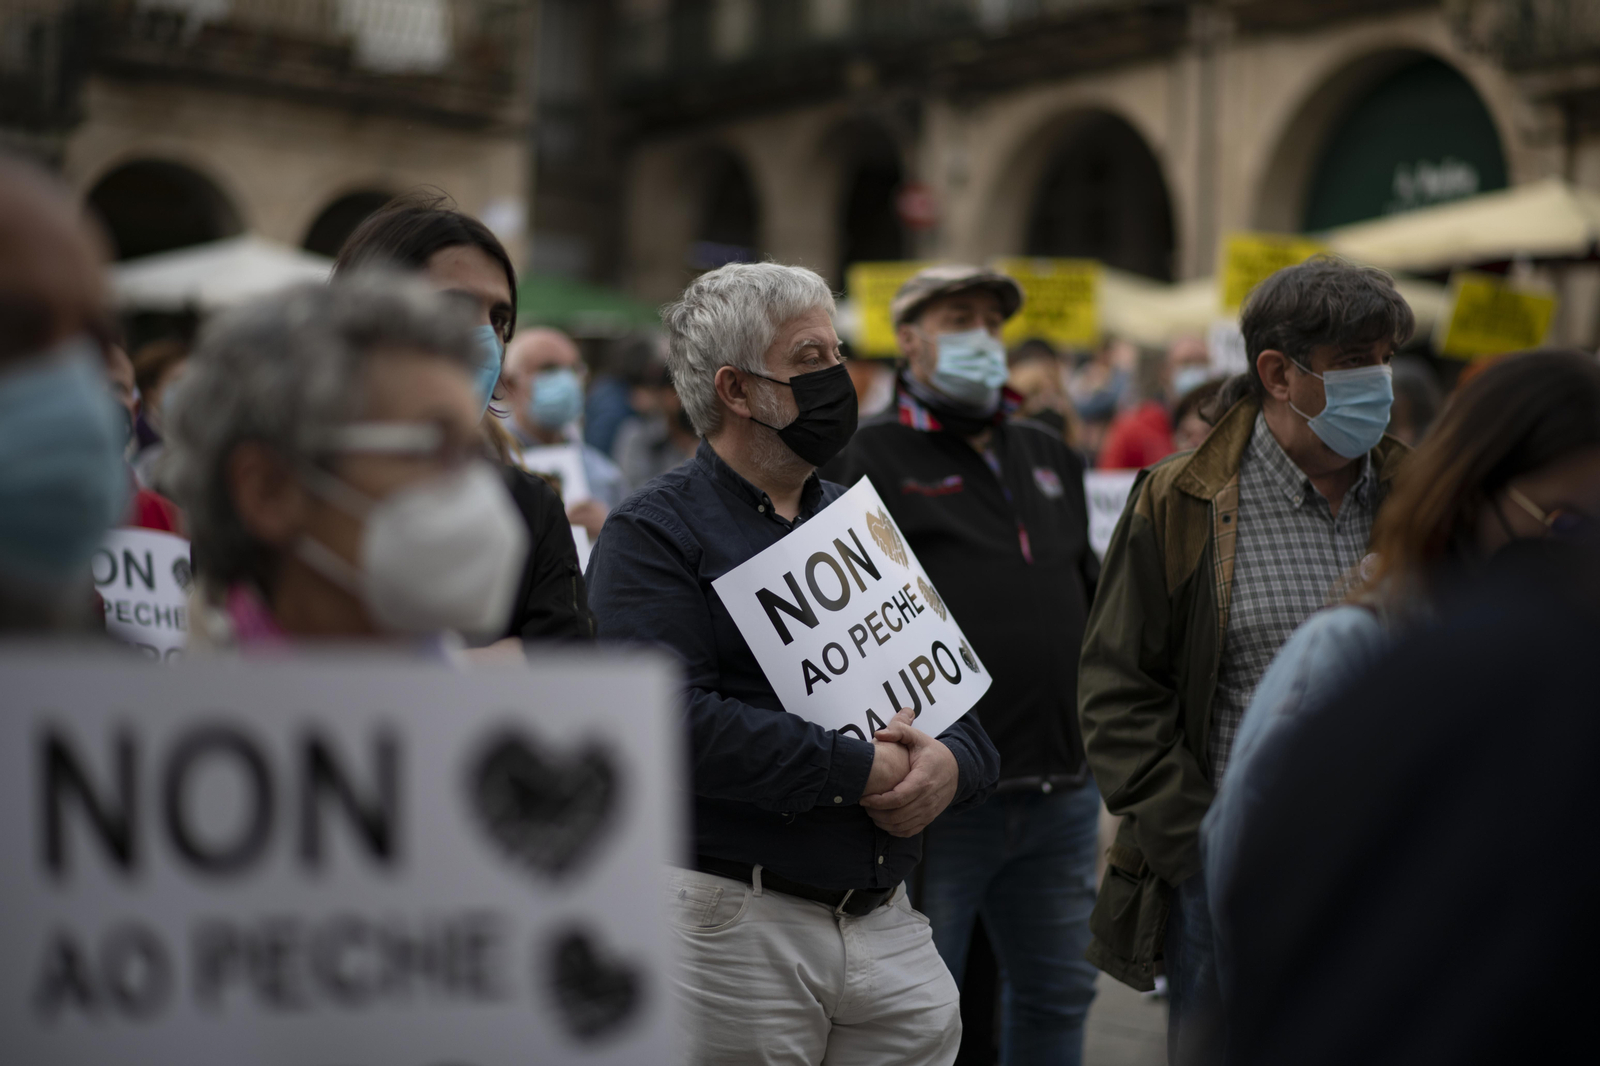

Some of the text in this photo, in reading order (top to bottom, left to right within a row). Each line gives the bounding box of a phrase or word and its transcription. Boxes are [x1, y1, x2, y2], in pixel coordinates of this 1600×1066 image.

[93, 548, 155, 591] ON
[755, 527, 882, 646] NON
[801, 583, 925, 696] AO PECHE
[882, 640, 962, 720] UPO
[34, 722, 402, 882] NON
[30, 914, 502, 1026] AO PECHE
